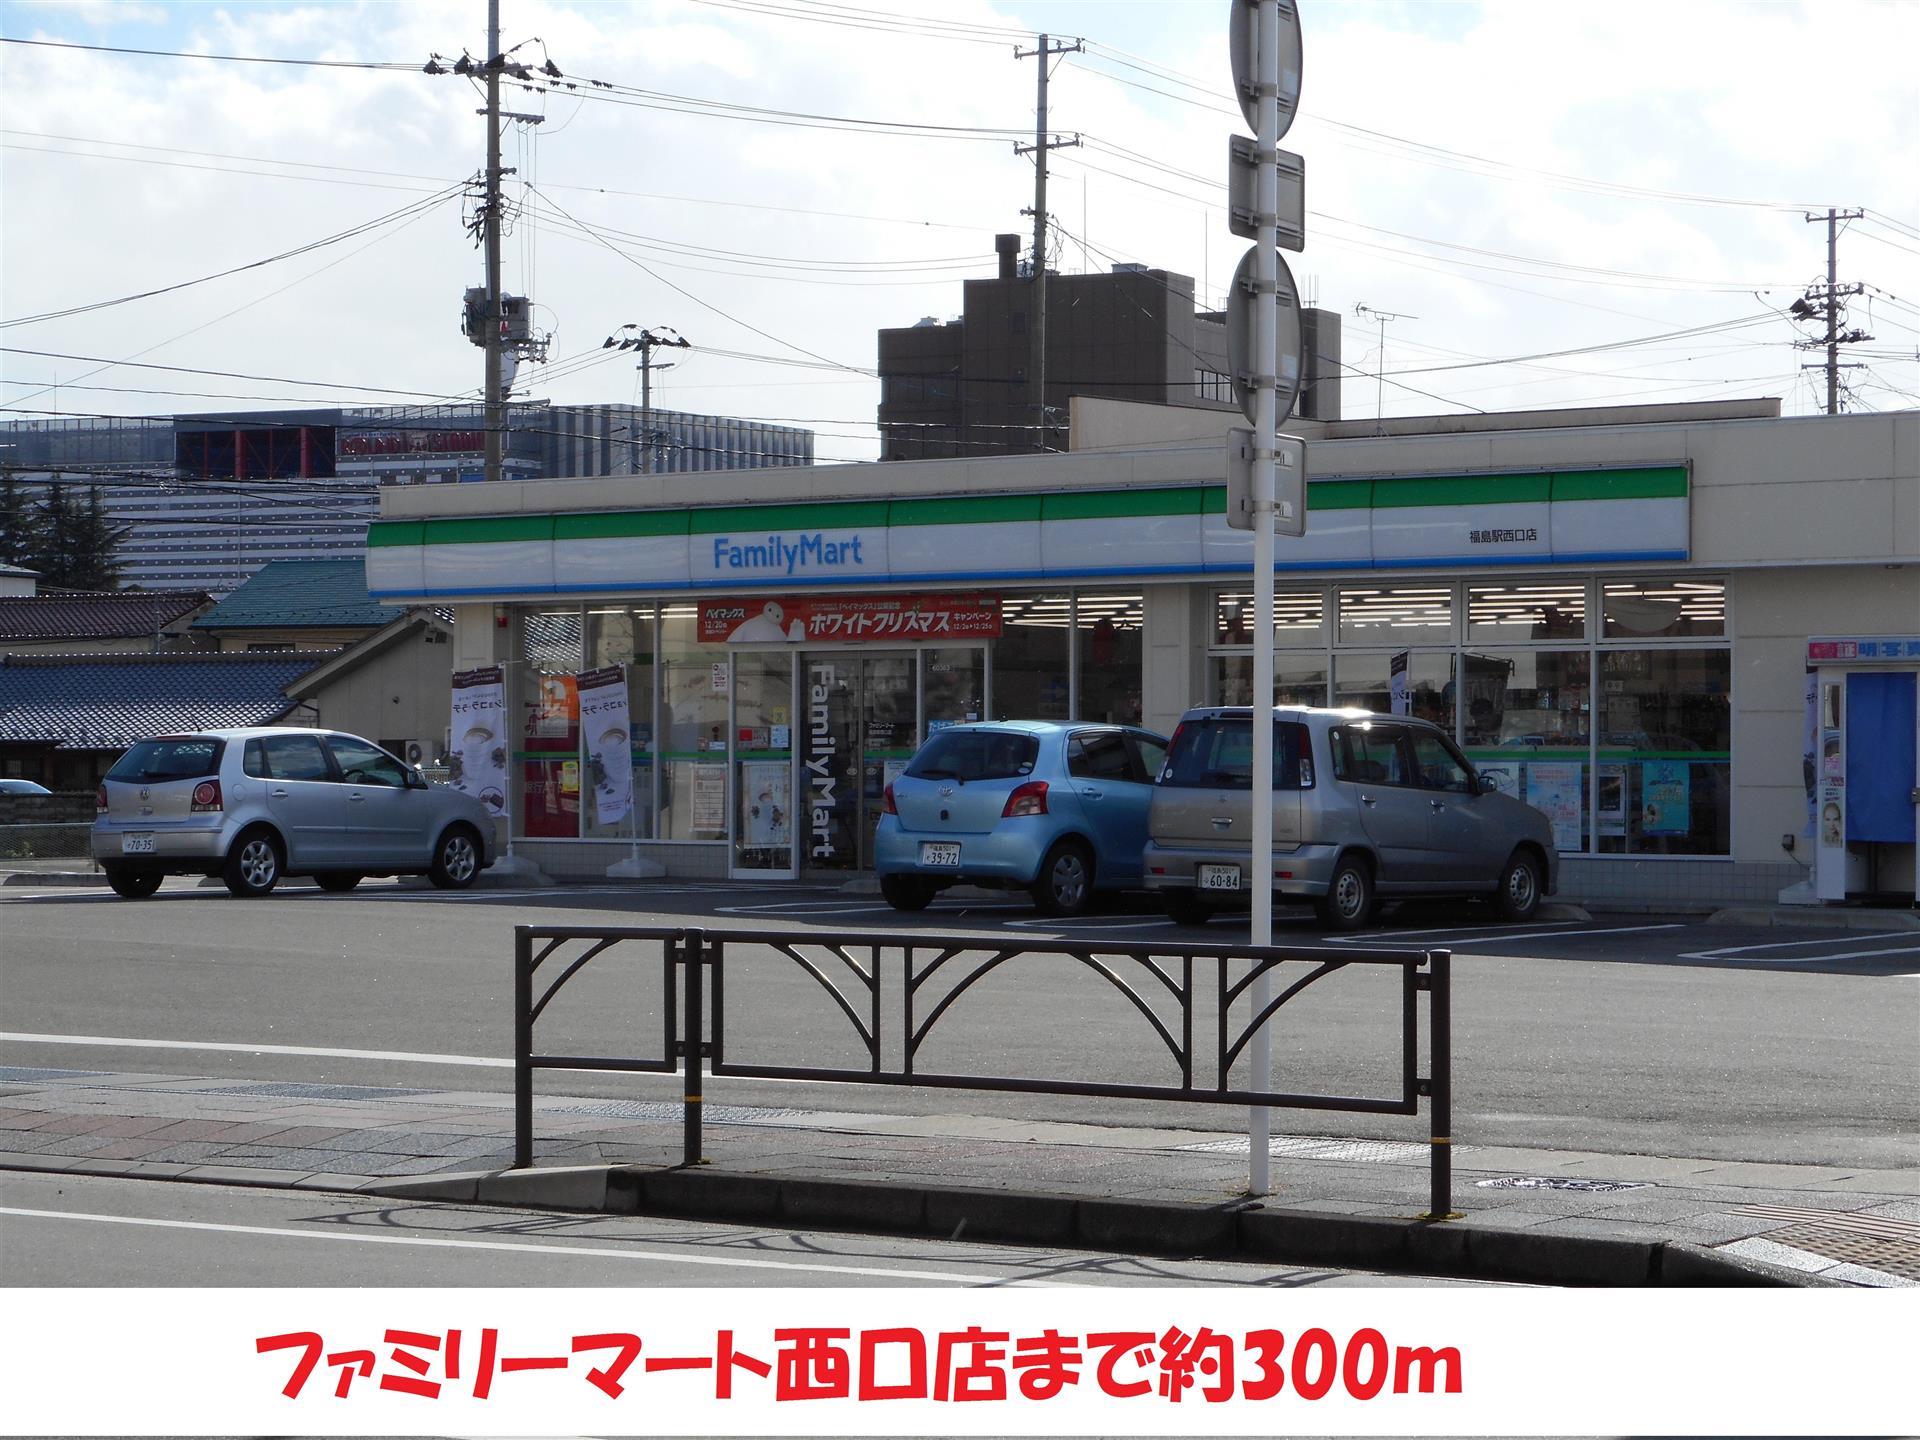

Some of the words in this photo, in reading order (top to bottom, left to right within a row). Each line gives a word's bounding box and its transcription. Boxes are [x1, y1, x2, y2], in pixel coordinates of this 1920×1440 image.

[1469, 528, 1537, 543] 福島駅西口店
[714, 533, 863, 575] FamilyMart
[809, 611, 950, 635] ホワイトクリスマス
[805, 665, 836, 858] FamilyMart
[131, 840, 153, 850] 70-35
[931, 852, 957, 865] 39-72
[1210, 875, 1238, 888] 60-84
